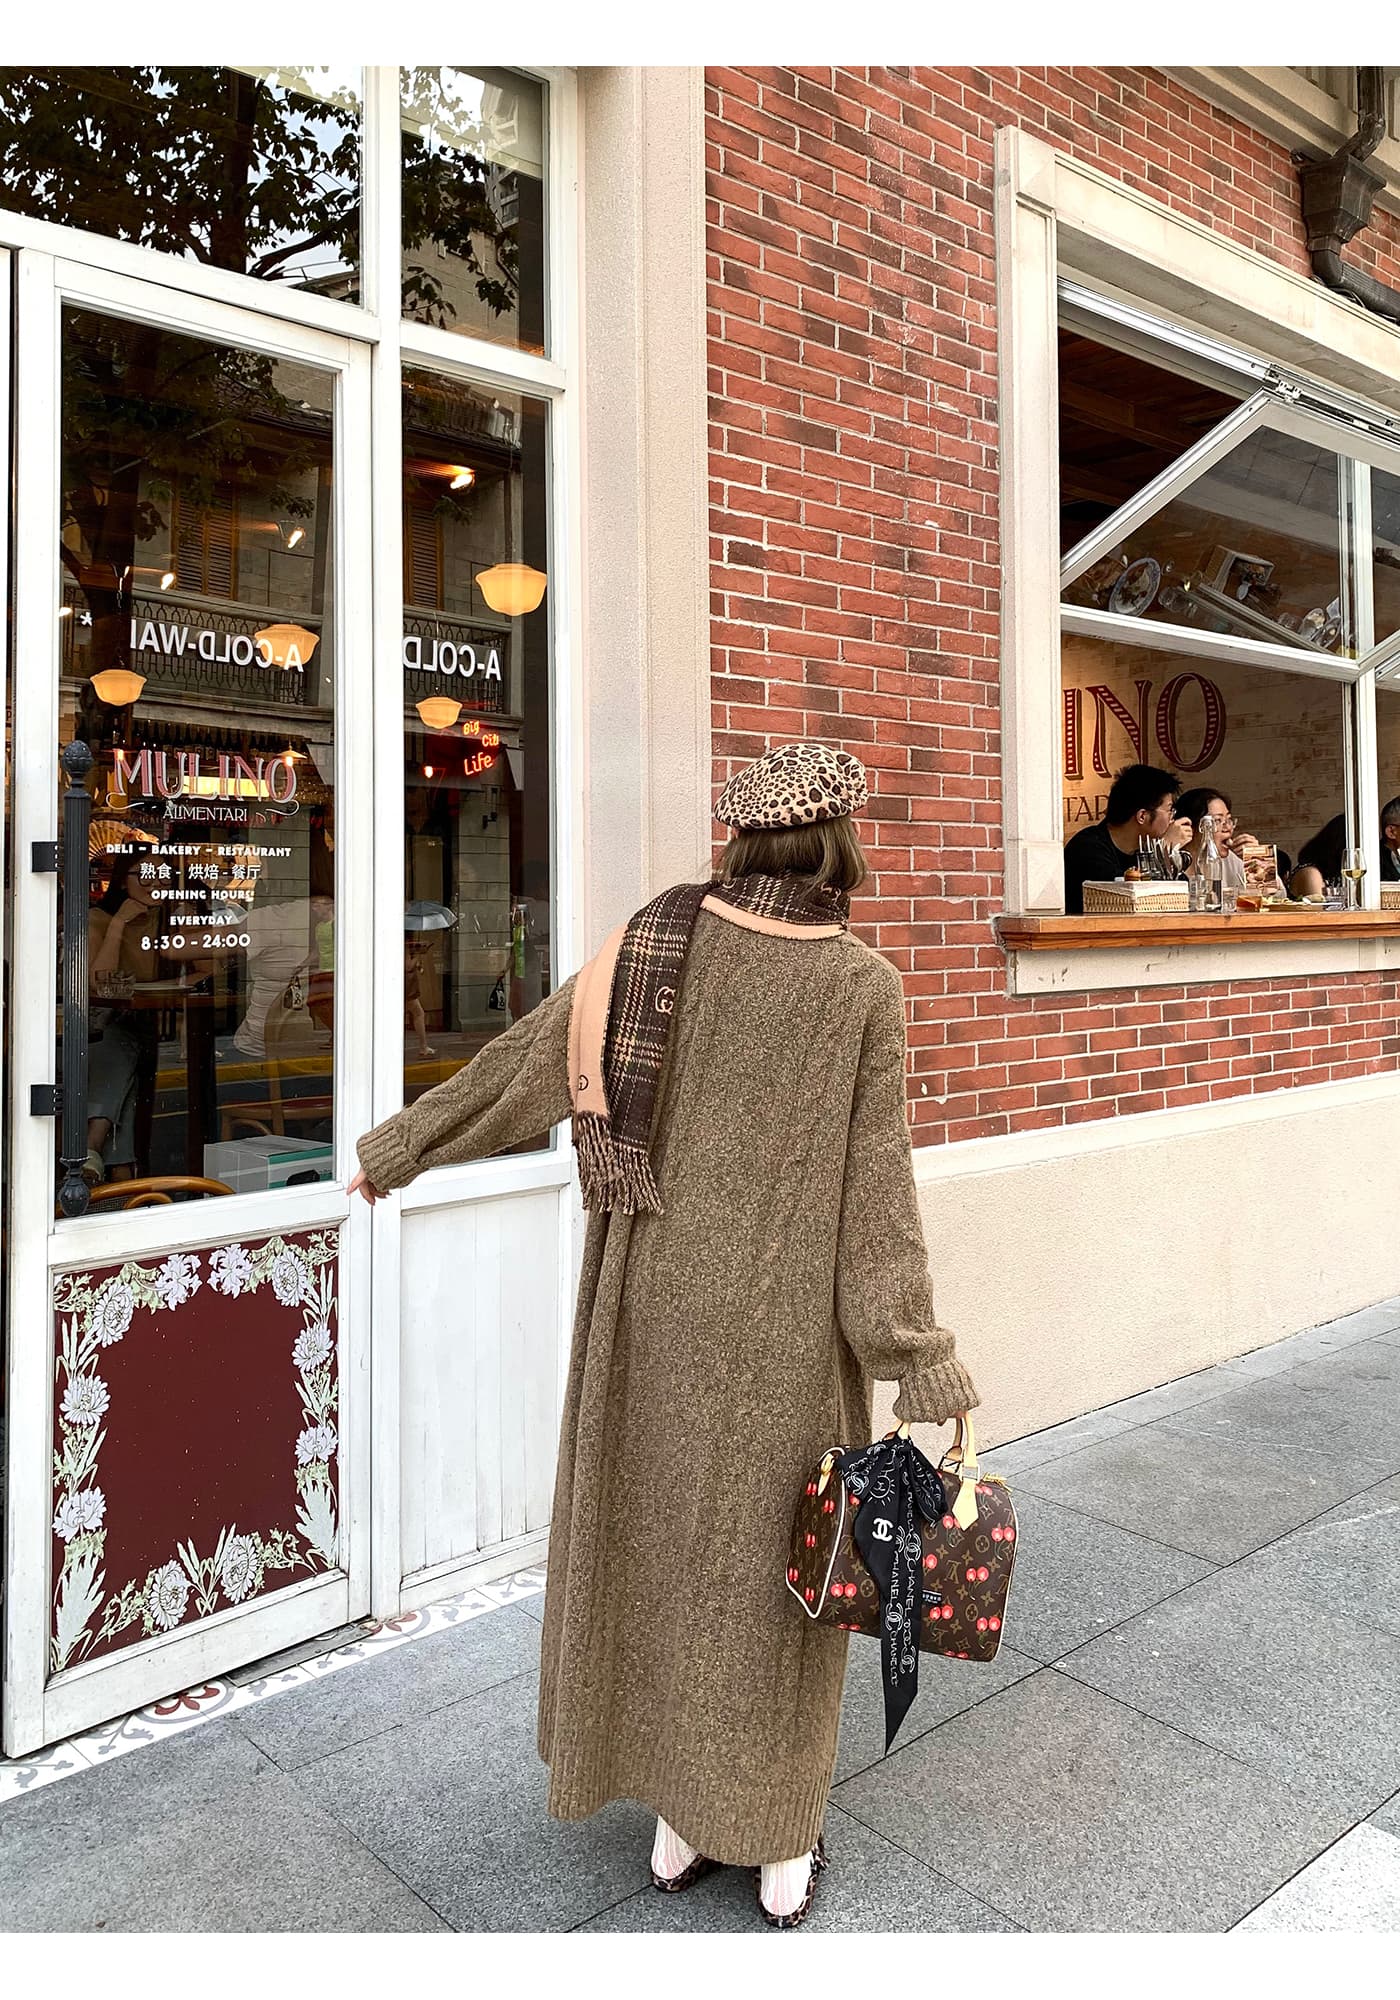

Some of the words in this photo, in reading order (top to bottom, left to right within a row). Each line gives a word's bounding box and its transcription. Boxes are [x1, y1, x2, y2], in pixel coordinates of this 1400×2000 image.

[463, 720, 480, 736] Big
[464, 752, 493, 775] Life
[113, 749, 297, 803] MULINO
[162, 804, 248, 823] ALIMENTARI
[106, 844, 133, 854] DELI
[151, 845, 201, 856] BAKERY
[217, 846, 292, 857] RESTAURANT
[139, 862, 172, 880] 熟食
[187, 863, 220, 880] 烘焙
[231, 864, 261, 880] 餐厅
[151, 889, 207, 900] OPENING
[169, 915, 233, 926] EVERYDAY
[140, 935, 186, 951] 8:30
[202, 933, 251, 949] 24:00
